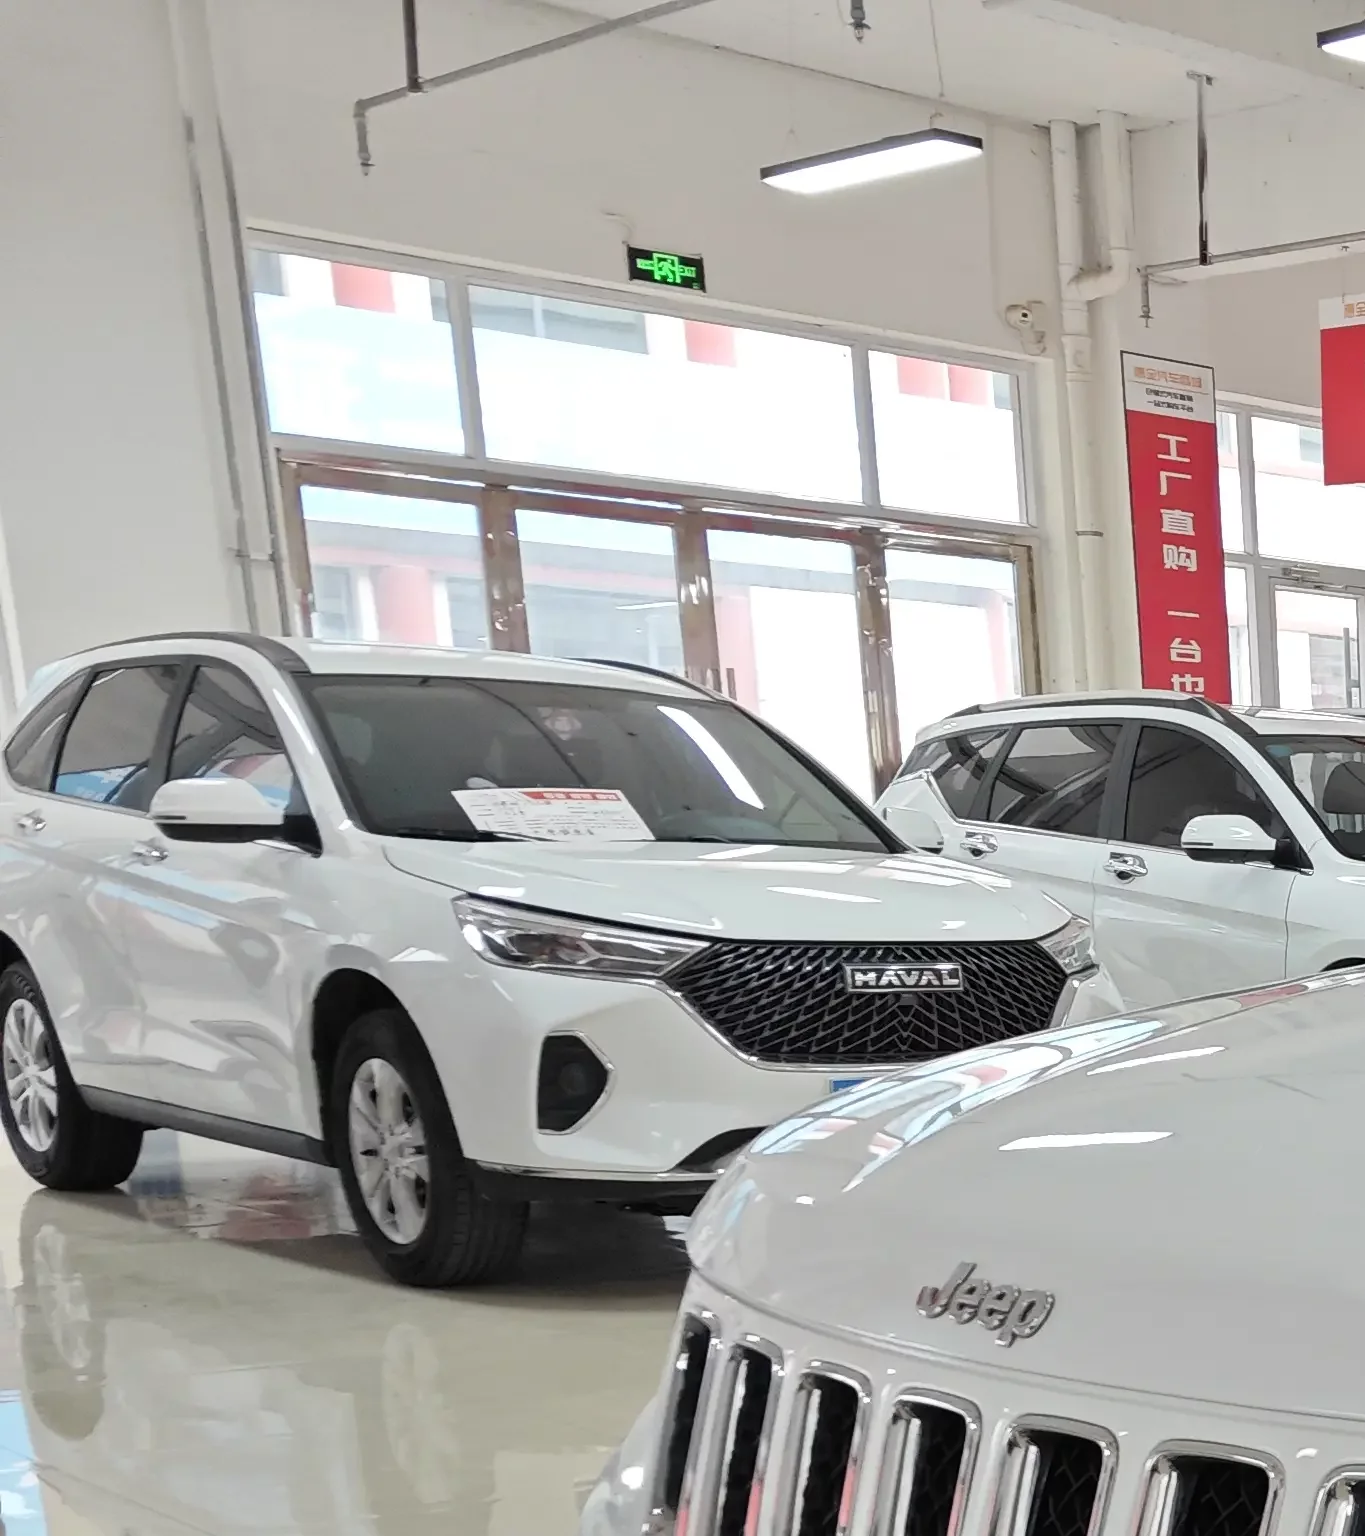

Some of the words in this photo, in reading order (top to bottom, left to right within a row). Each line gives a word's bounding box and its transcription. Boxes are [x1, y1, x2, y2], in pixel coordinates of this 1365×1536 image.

[1157, 433, 1198, 572] 工厂直购
[853, 970, 960, 987] HAVAL
[916, 1261, 1055, 1348] Jeep
